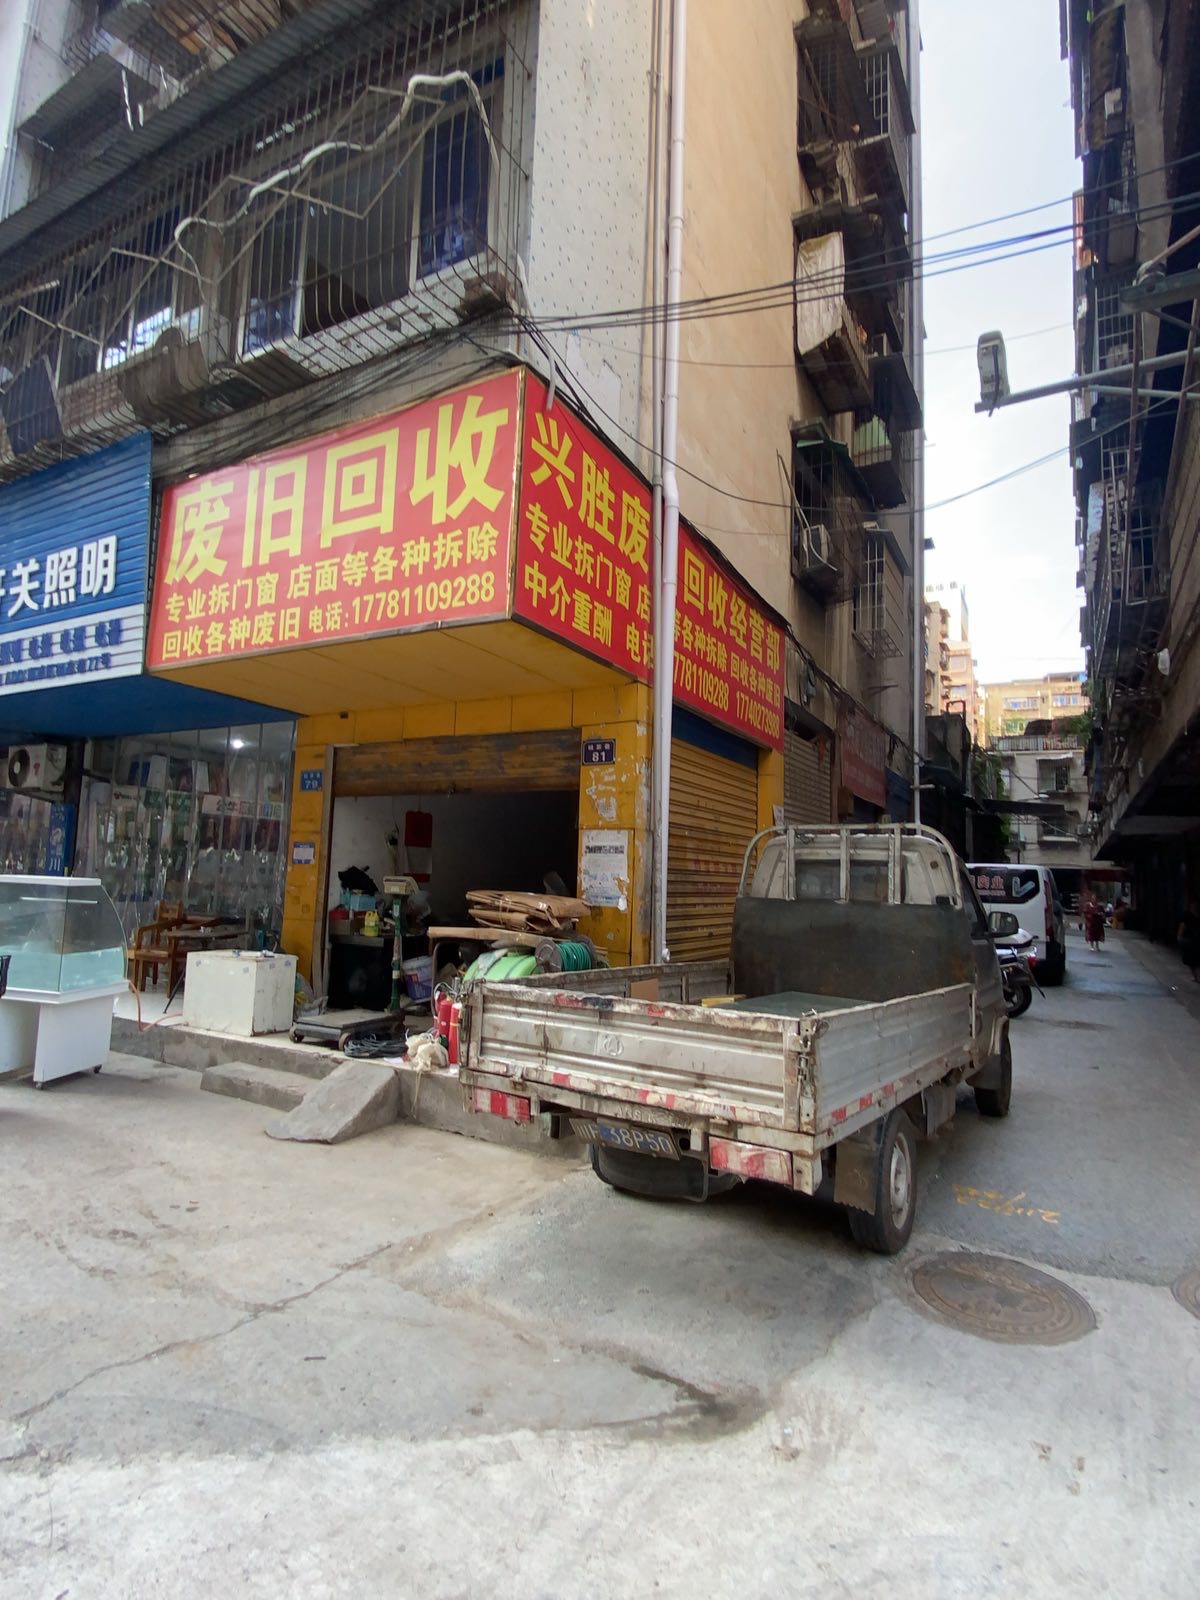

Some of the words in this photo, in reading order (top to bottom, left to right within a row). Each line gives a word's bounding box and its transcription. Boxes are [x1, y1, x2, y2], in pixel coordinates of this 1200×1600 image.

[164, 395, 508, 586] 废旧回收
[165, 571, 278, 624] 专业拆门窗
[287, 521, 499, 601] 店面等各种拆除
[524, 560, 613, 649] 中介重酬
[525, 502, 632, 611] 专业拆门窗
[731, 652, 781, 708] 回收各种废旧
[161, 606, 300, 662] 回收各种废旧
[592, 751, 606, 762] 81
